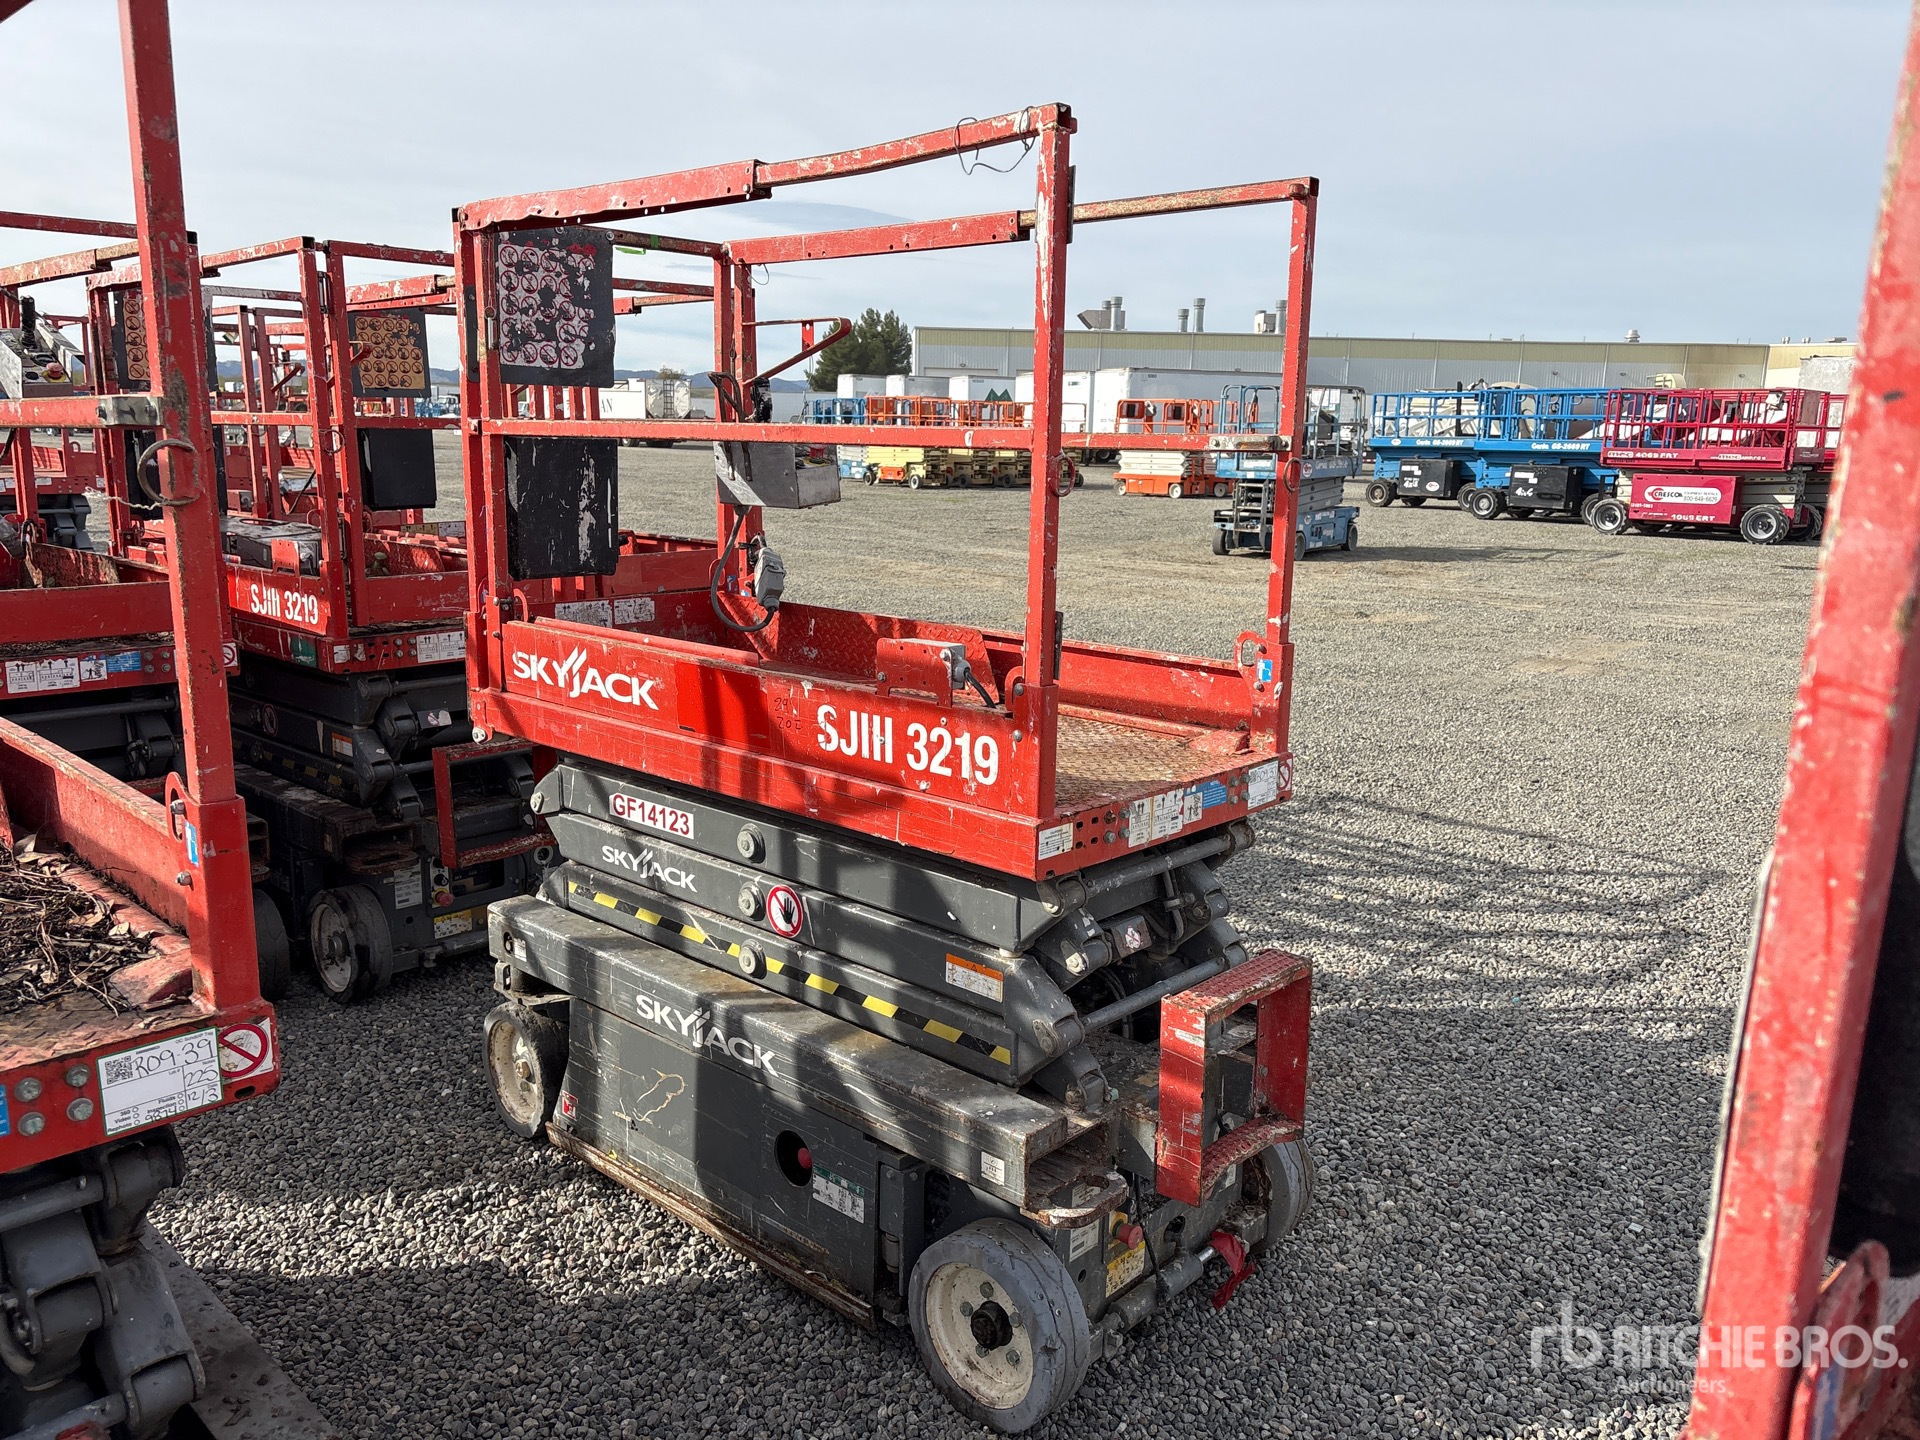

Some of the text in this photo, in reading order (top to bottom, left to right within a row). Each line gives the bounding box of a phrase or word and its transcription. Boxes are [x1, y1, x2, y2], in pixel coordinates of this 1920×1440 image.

[1531, 442, 1549, 450] Genie
[284, 591, 319, 625] 3219
[512, 646, 660, 711] SKYJACK
[906, 722, 999, 786] 3219
[612, 794, 690, 836] GF14123
[602, 845, 698, 893] SKYJACK
[635, 994, 780, 1078] SKYJACK
[184, 1065, 219, 1087] 225
[114, 1116, 131, 1124] Video
